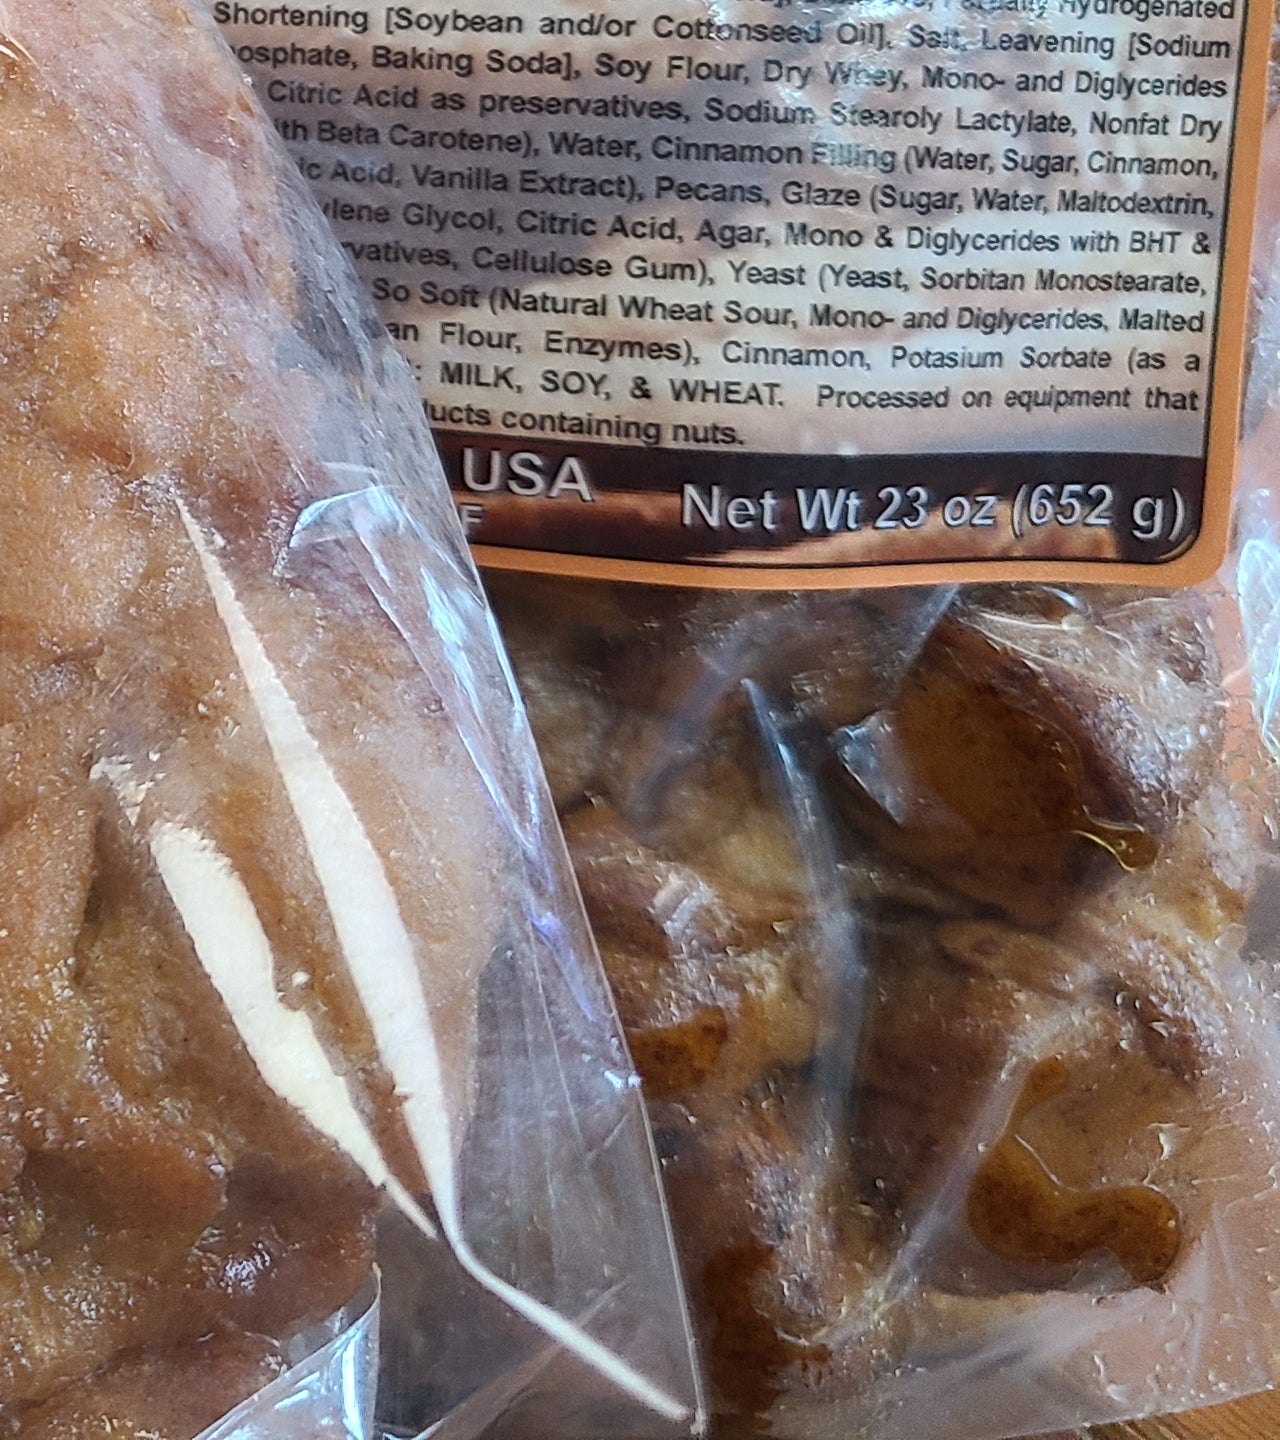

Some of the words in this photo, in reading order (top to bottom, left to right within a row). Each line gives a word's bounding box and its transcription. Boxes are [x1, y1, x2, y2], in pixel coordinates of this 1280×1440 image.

[333, 162, 400, 187] Acid,
[410, 165, 508, 192] Vanilla
[519, 172, 644, 201] Extract),
[654, 177, 770, 206] Pecans,
[782, 182, 860, 208] Glaze
[869, 186, 964, 215] (Sugar,
[972, 187, 1049, 214] Water,
[1057, 189, 1214, 218] Maltodextrin,
[403, 203, 503, 233] Glycol,
[516, 210, 597, 236] Citric
[607, 216, 683, 243] Acid,
[694, 220, 772, 249] Agar,
[785, 223, 863, 247] Mono
[875, 225, 895, 249] &
[907, 226, 1060, 256] Diglycerides
[1070, 230, 1119, 254] with
[1129, 231, 1181, 253] BHT
[1192, 233, 1211, 255] &
[373, 278, 411, 302] So
[420, 282, 479, 307] Soft
[489, 287, 607, 317] (Natural
[619, 297, 713, 322] Wheat
[724, 301, 798, 329] Sour,
[809, 303, 895, 328] Mono-
[903, 307, 951, 329] and
[957, 307, 1109, 335] Diglycerides,
[1119, 309, 1204, 333] Malted
[440, 362, 523, 393] MILK,
[540, 368, 611, 399] SOY,
[631, 376, 651, 398] &
[669, 378, 783, 407] WHEAT.
[817, 385, 949, 409] Processed
[962, 389, 992, 408] on
[1004, 386, 1130, 411] equipment
[1144, 388, 1198, 410] that
[502, 408, 661, 445] containing
[672, 422, 744, 446] nuts.
[462, 447, 592, 501] USA
[682, 485, 779, 532] Net
[797, 488, 863, 532] Wt
[874, 488, 927, 529] 23
[943, 495, 996, 527] oz
[1012, 483, 1114, 534] (652
[1132, 486, 1186, 540] g)
